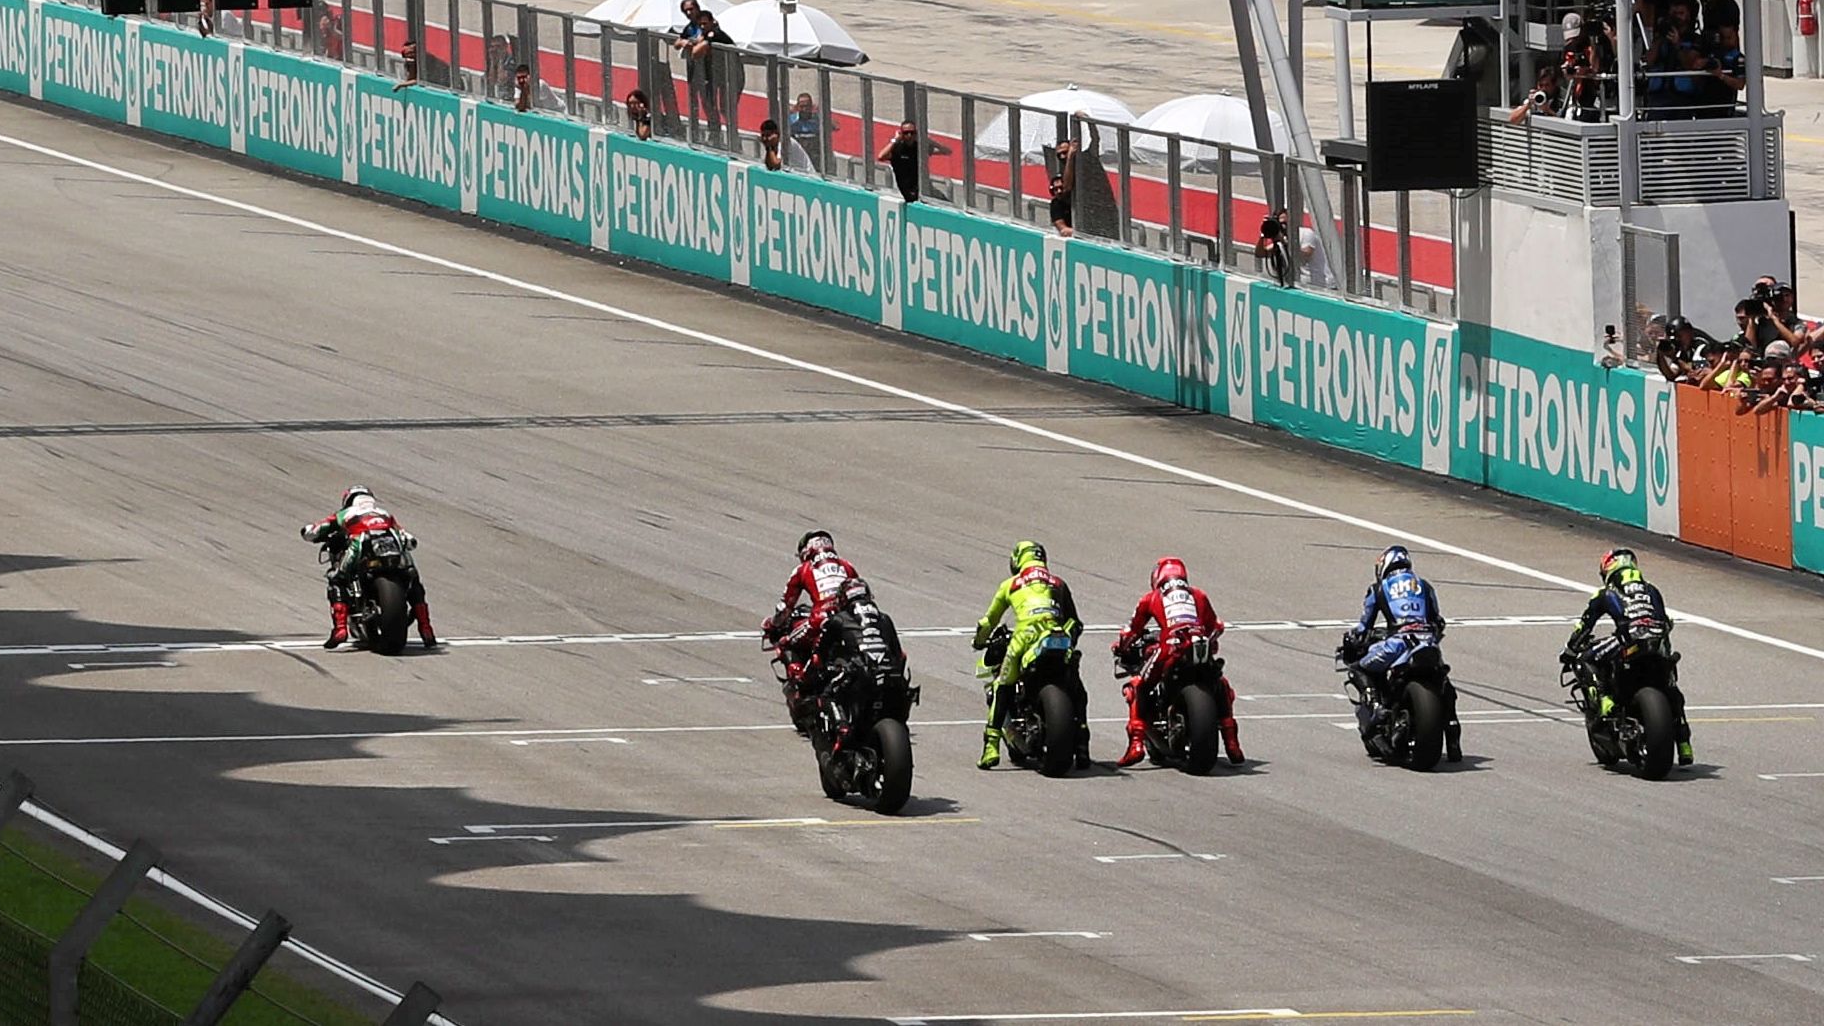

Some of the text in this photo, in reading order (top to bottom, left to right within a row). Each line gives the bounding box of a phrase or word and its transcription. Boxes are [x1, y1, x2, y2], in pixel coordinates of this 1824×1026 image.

[44, 17, 124, 102] PETRONAS
[141, 41, 228, 126] PETRONAS
[248, 66, 338, 157] PETRONAS
[361, 93, 458, 187] PETRONAS
[479, 120, 585, 221] PETRONAS
[612, 152, 724, 255] PETRONAS
[754, 178, 875, 296] PETRONAS
[906, 222, 1040, 341] PETRONAS
[1074, 262, 1219, 386] PETRONAS
[1259, 305, 1416, 436] PETRONAS
[1459, 353, 1638, 494] PETRONAS
